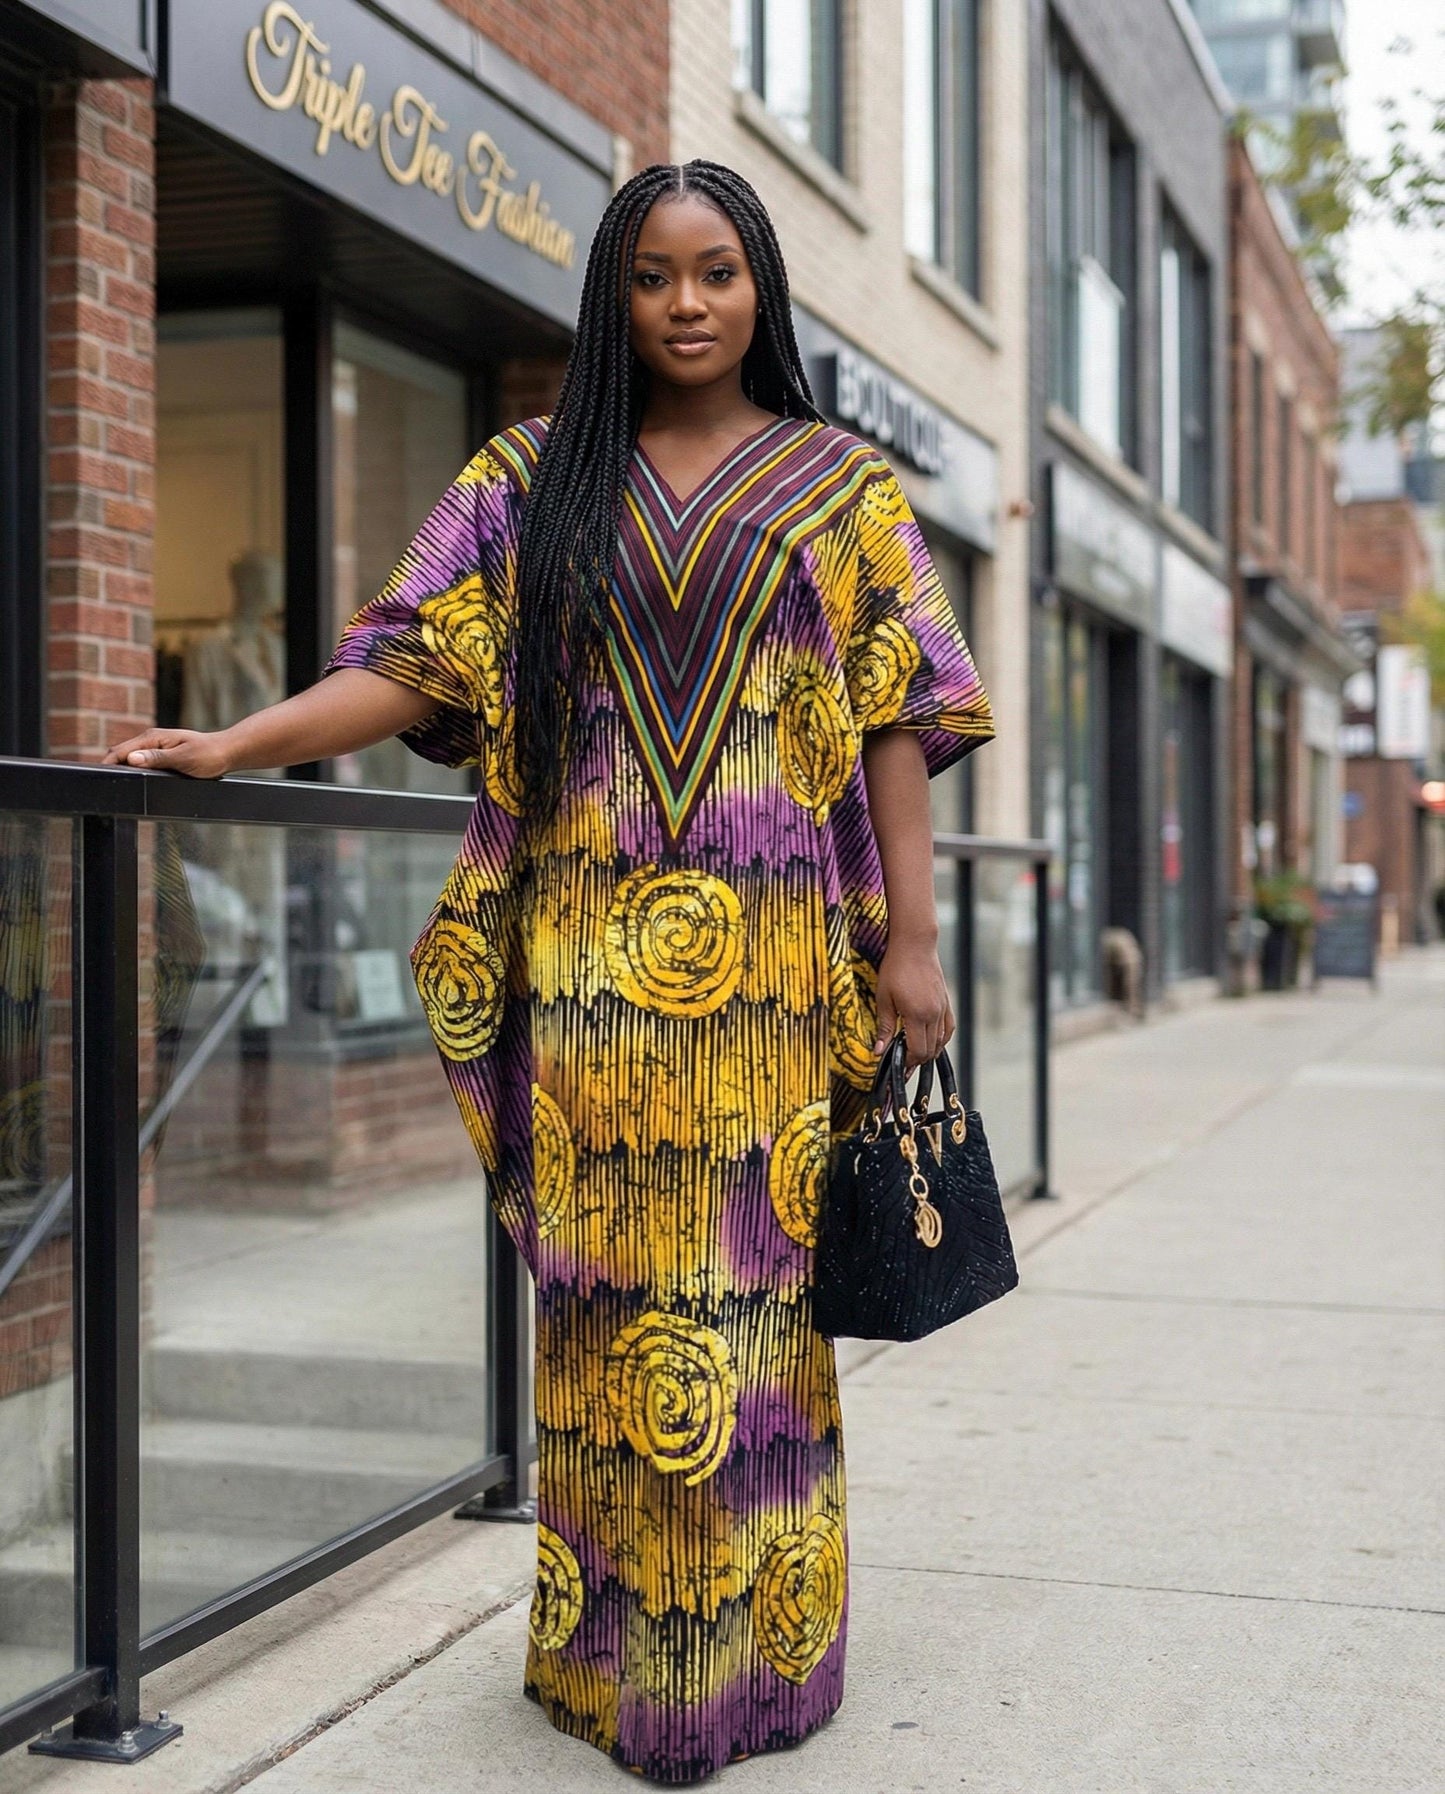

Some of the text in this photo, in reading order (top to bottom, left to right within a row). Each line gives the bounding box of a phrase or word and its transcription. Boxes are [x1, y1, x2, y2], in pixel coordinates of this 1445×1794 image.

[247, 0, 575, 270] Triple Tee Fashion
